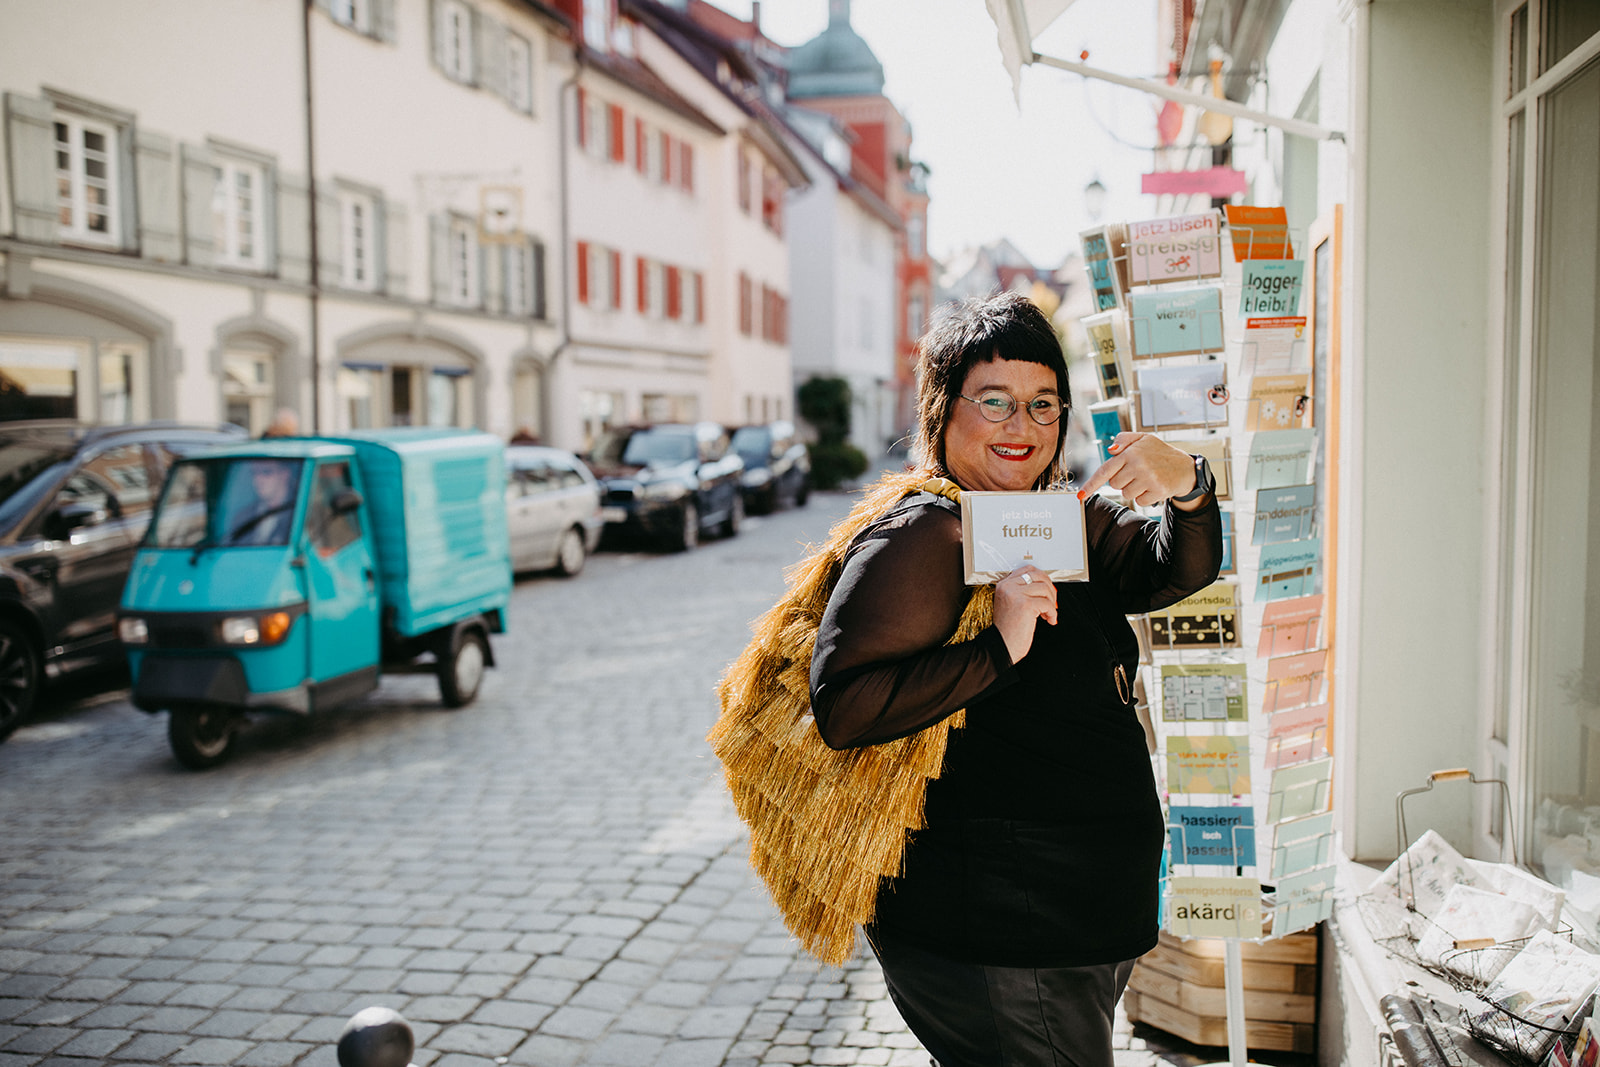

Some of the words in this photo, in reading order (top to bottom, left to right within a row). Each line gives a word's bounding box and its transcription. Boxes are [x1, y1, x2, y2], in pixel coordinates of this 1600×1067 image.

[1135, 222, 1165, 240] jetz
[1169, 215, 1213, 233] bisch
[1248, 272, 1298, 294] logger
[1156, 308, 1197, 321] vierzig
[1002, 510, 1021, 521] jetz
[1024, 509, 1052, 519] bisch
[1002, 524, 1053, 540] fuffzig
[1181, 814, 1242, 827] bassierd
